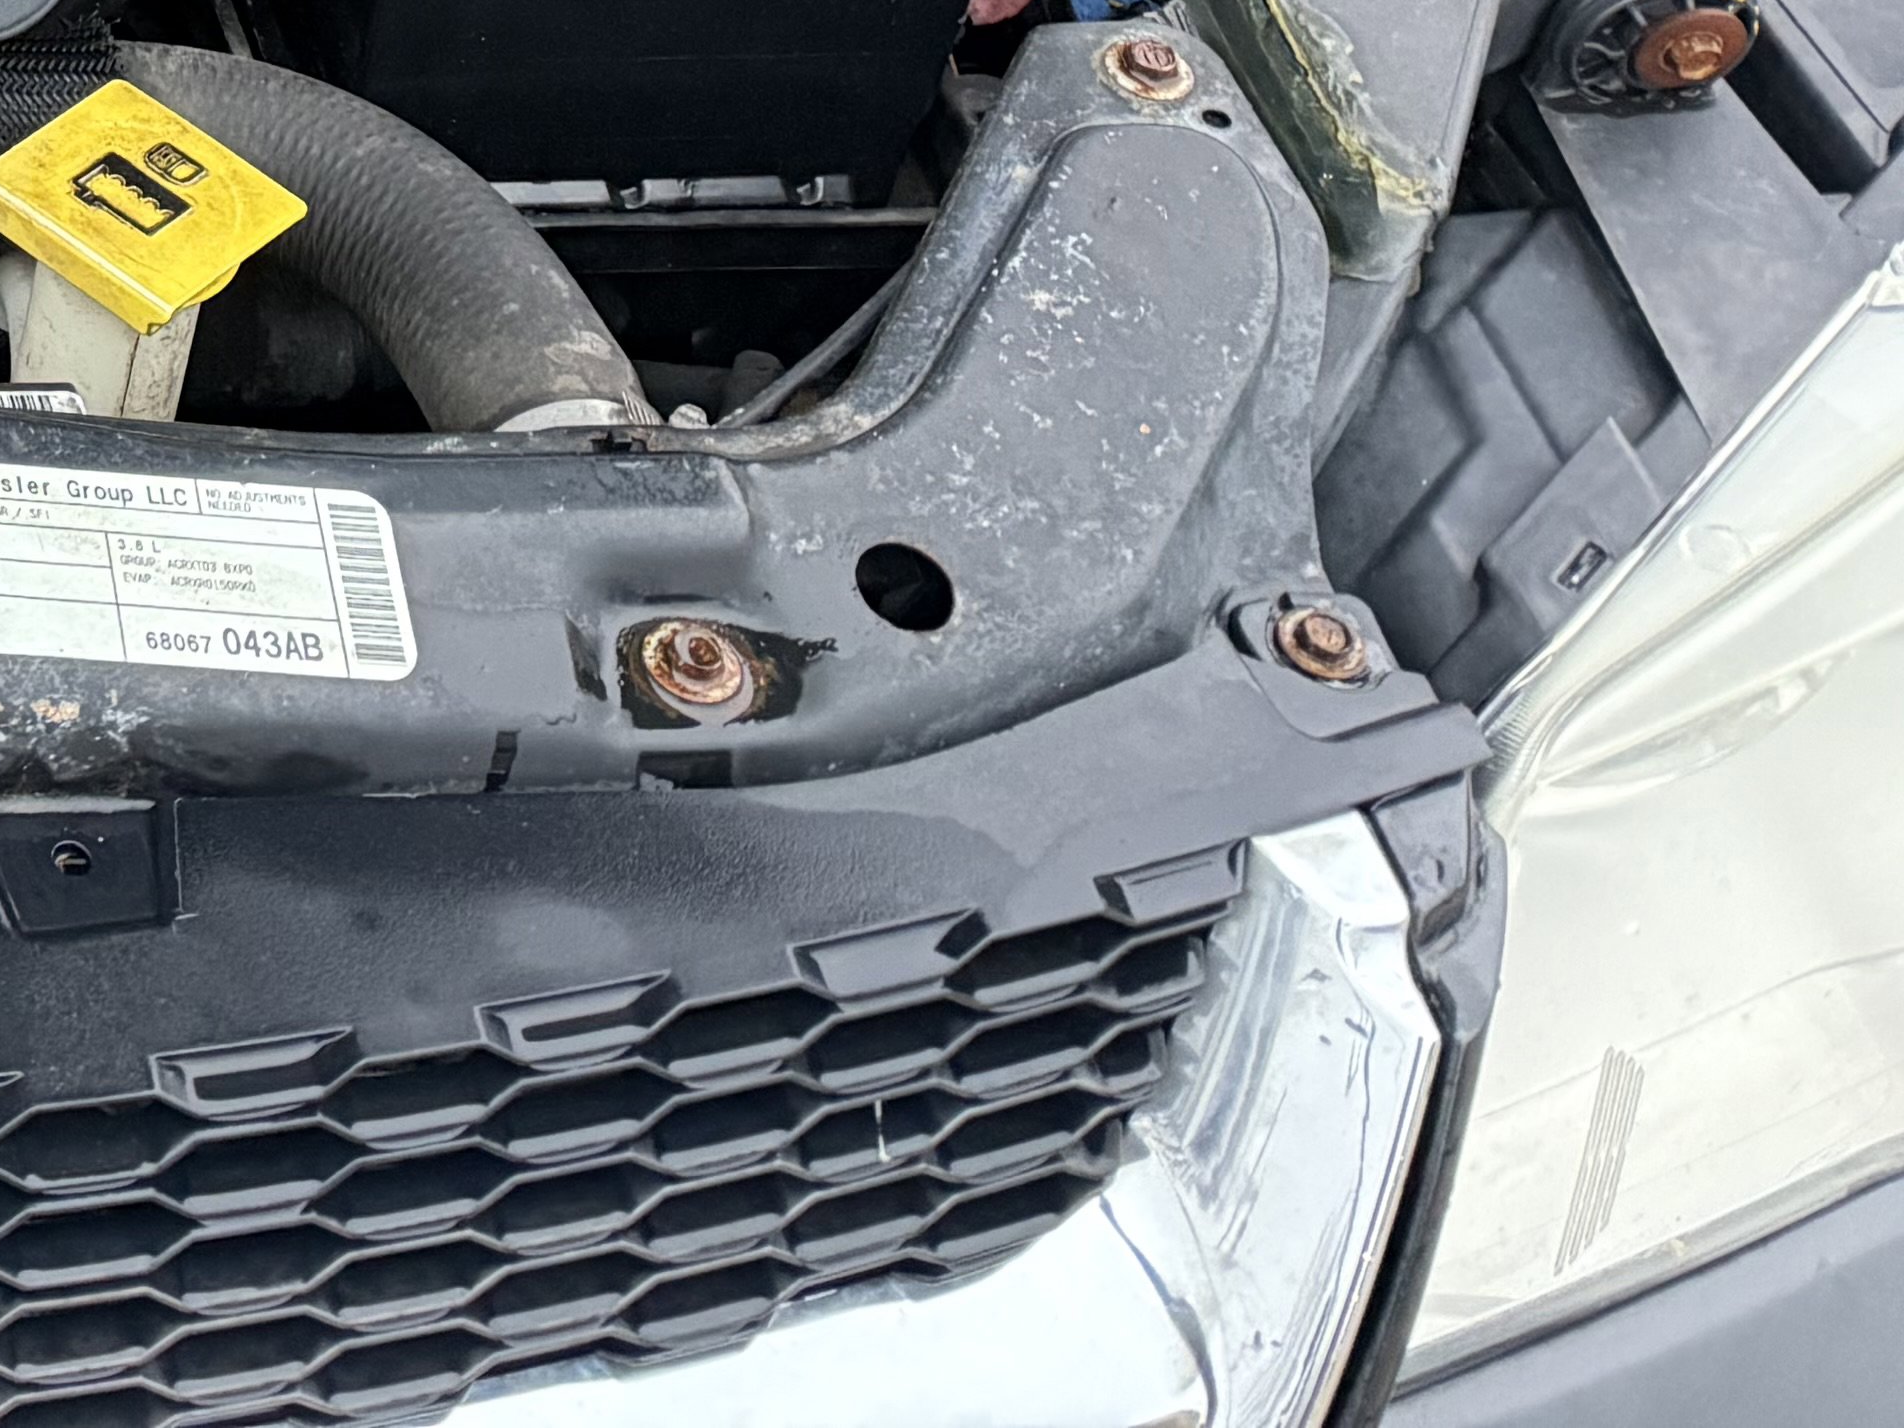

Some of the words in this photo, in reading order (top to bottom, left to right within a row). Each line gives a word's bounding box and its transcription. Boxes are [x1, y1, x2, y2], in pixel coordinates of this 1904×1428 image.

[66, 479, 133, 507] Group
[146, 485, 188, 506] LLC
[146, 631, 211, 654] 68067
[222, 627, 324, 661] 043AB
